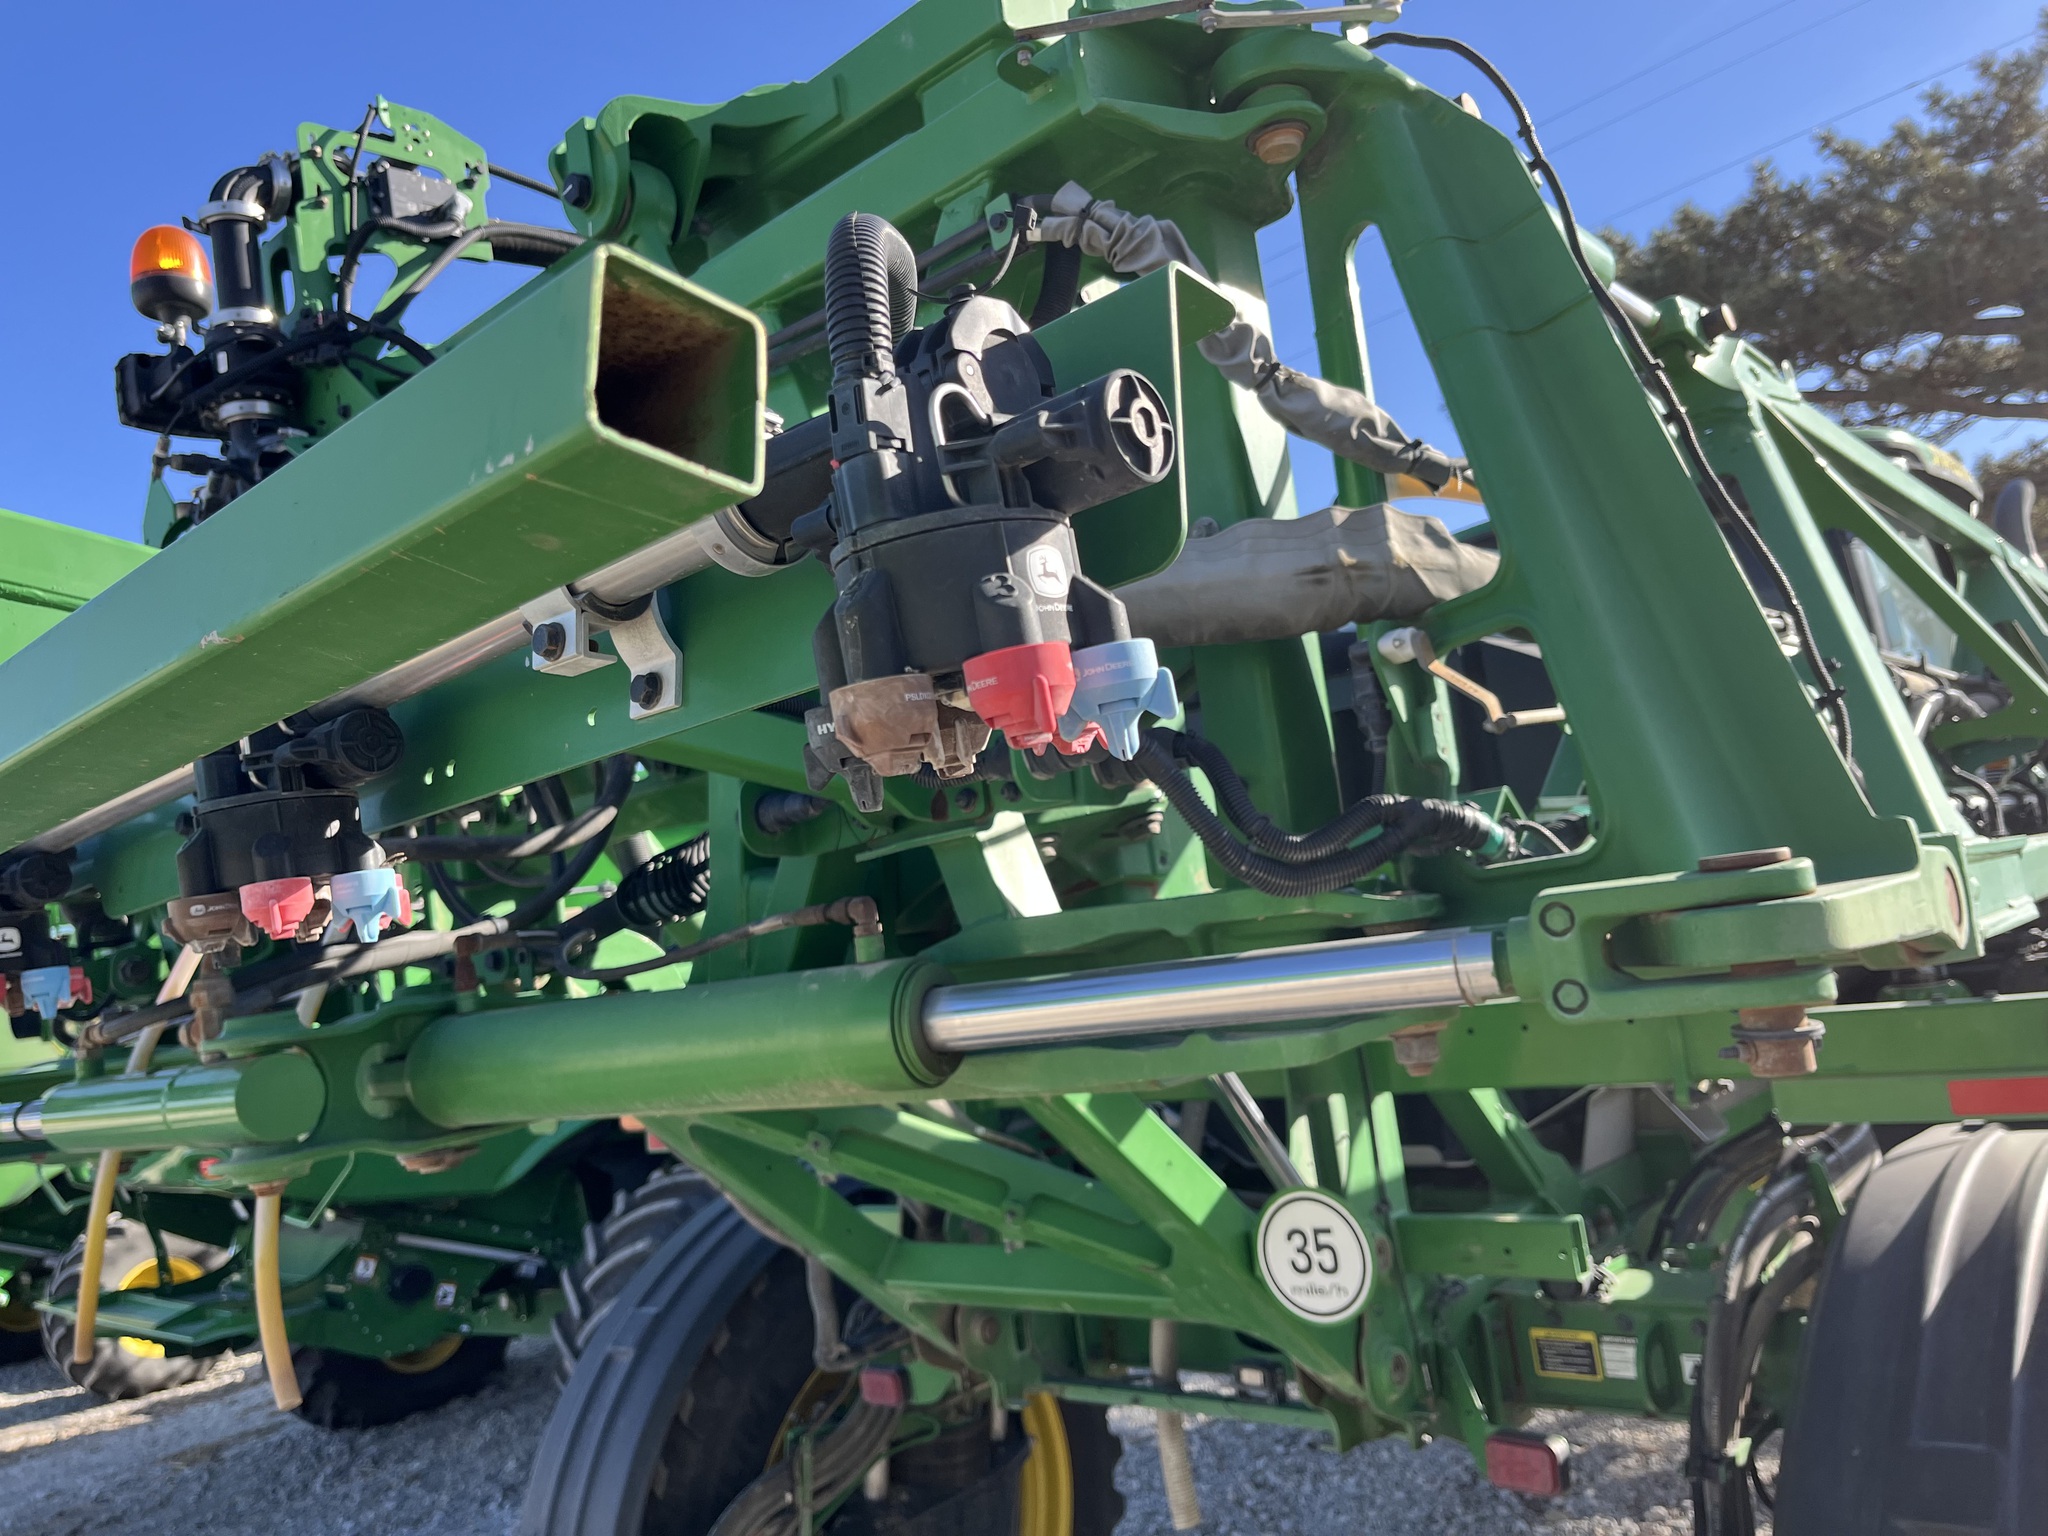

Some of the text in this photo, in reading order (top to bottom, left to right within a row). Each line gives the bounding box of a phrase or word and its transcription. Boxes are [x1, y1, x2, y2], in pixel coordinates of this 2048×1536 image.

[1082, 666, 1105, 678] JOHN
[971, 676, 999, 692] DEERE
[1287, 1228, 1338, 1274] 35
